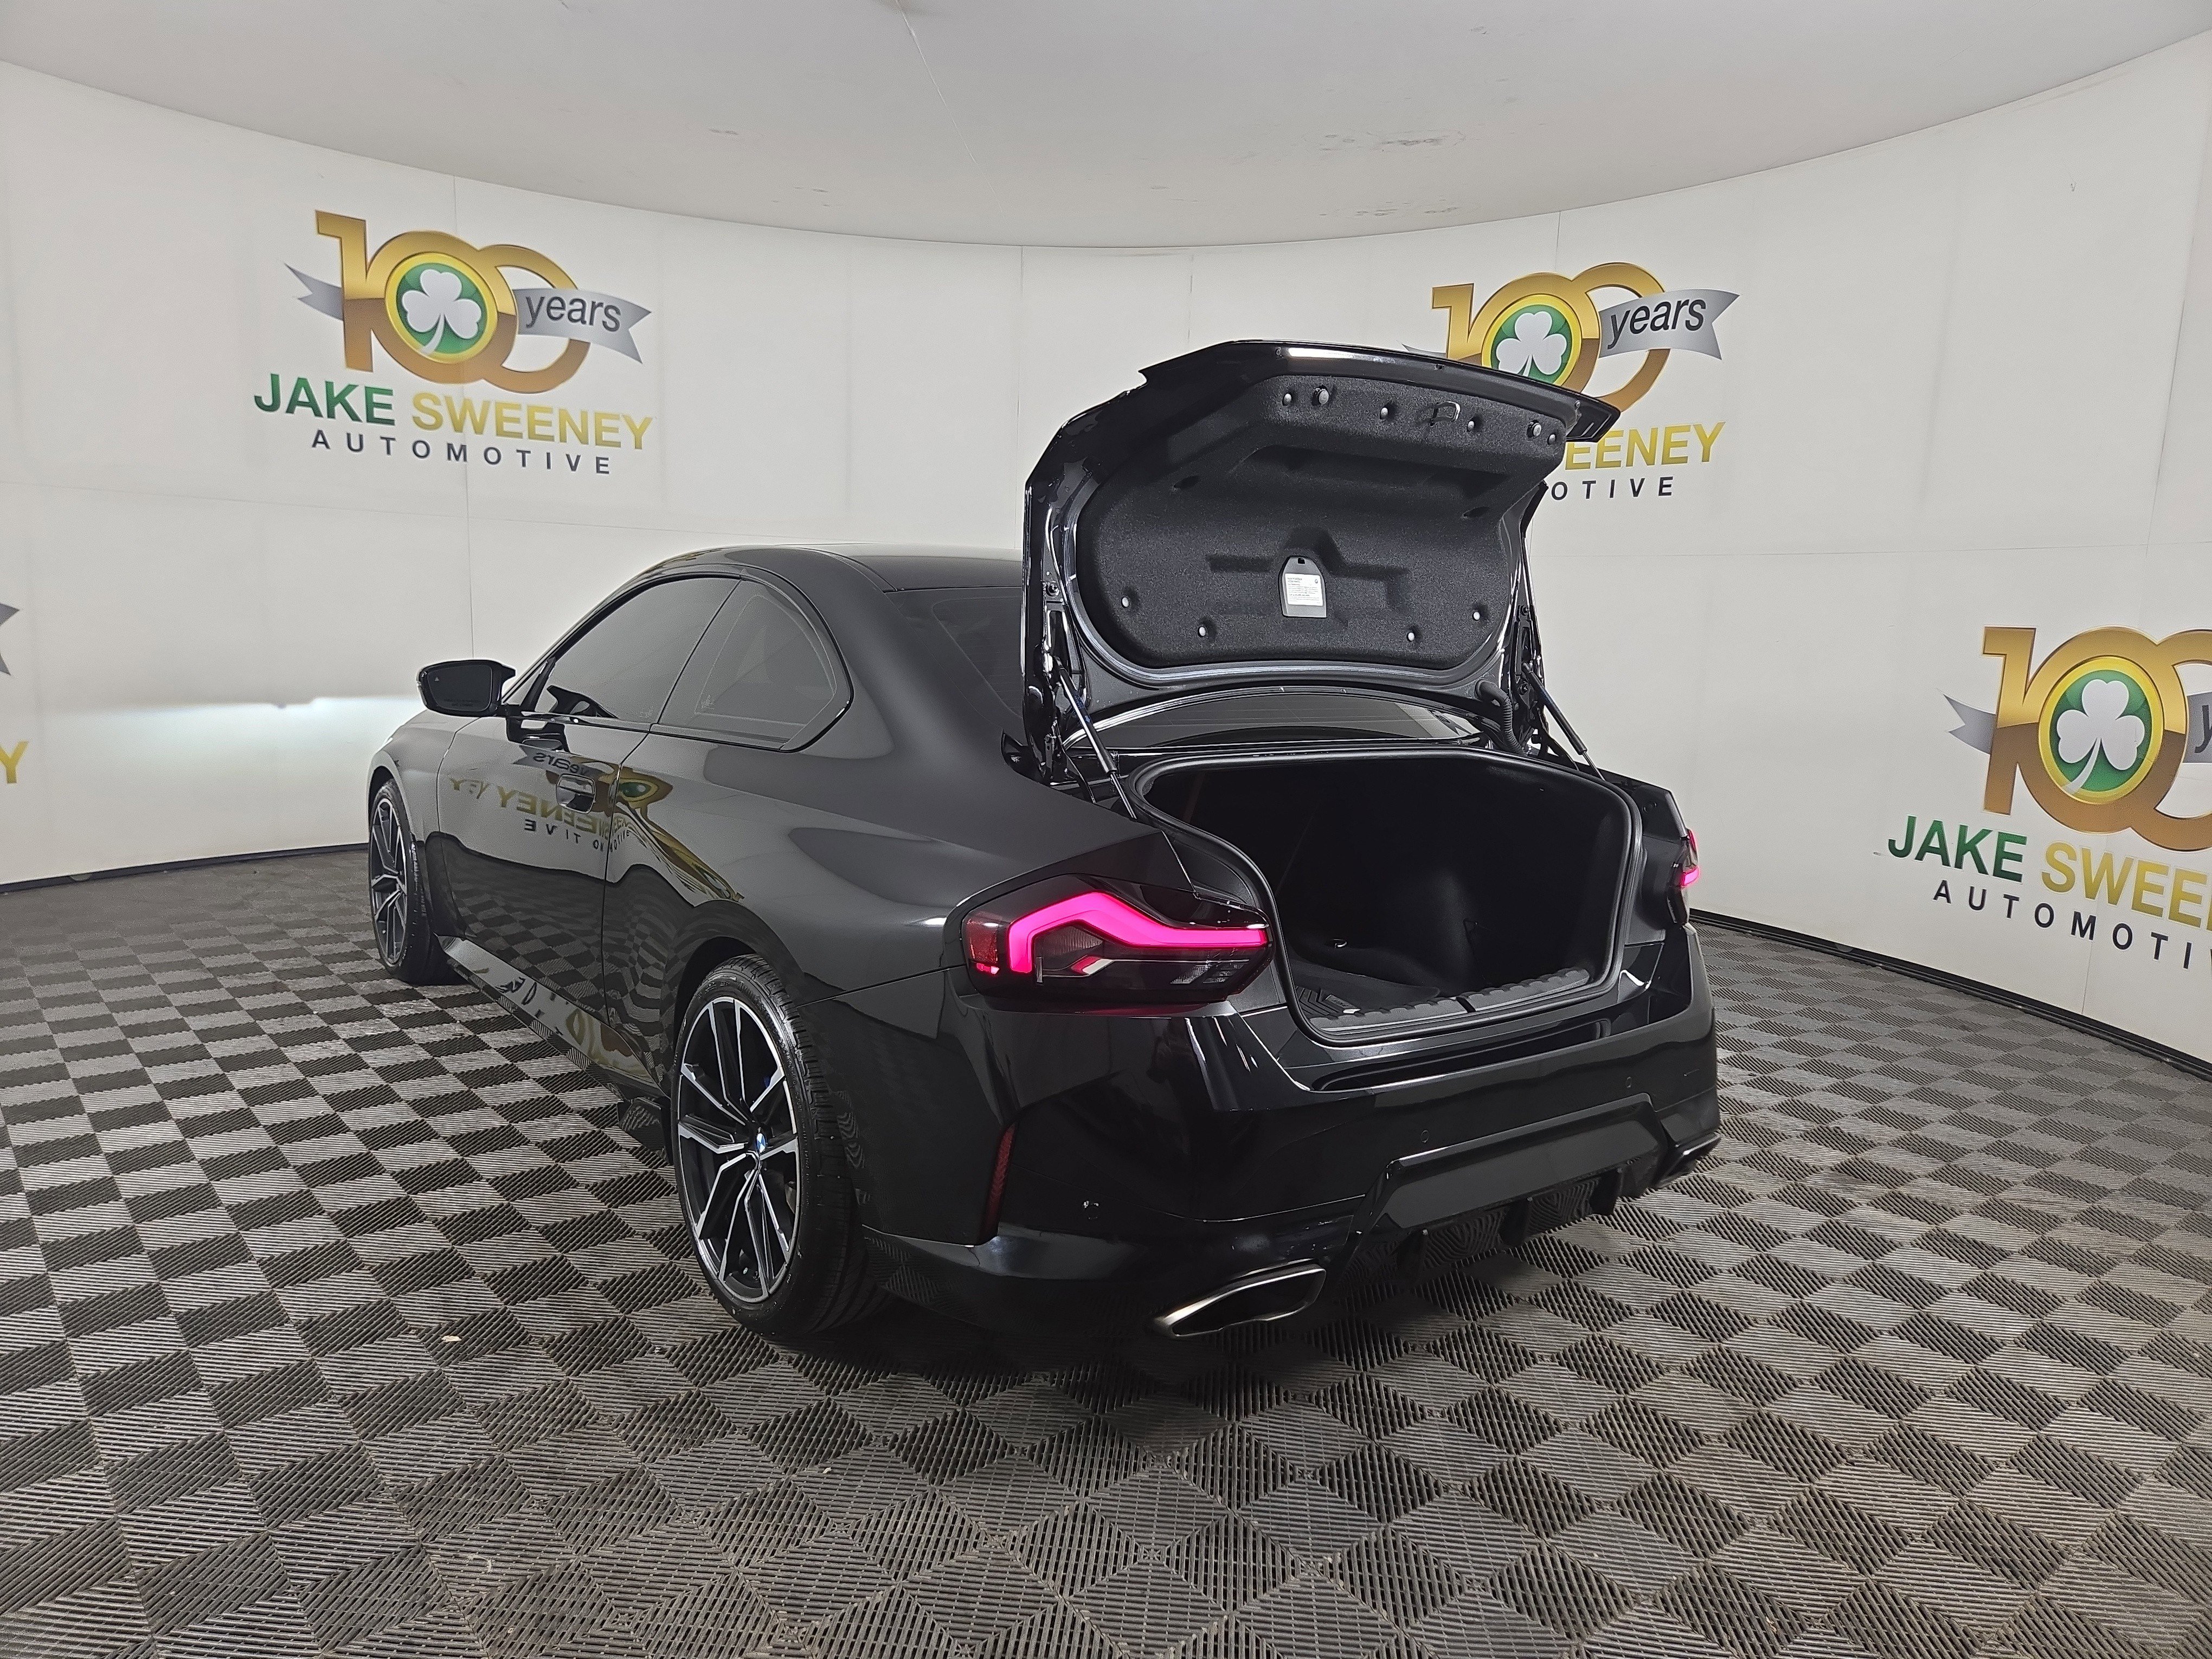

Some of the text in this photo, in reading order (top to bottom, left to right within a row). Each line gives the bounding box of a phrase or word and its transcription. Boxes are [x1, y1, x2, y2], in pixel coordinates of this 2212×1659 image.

[525, 296, 621, 332] years
[1607, 298, 1707, 350] years
[254, 373, 652, 450] JAKE SWEENEY
[312, 429, 610, 475] AUTOMOTIVE
[1565, 421, 1726, 471] EENEY
[1551, 476, 1674, 500] OTIVE
[1888, 815, 2212, 931] JAKE SWEE
[1933, 879, 2212, 969] AUTOMOTI
